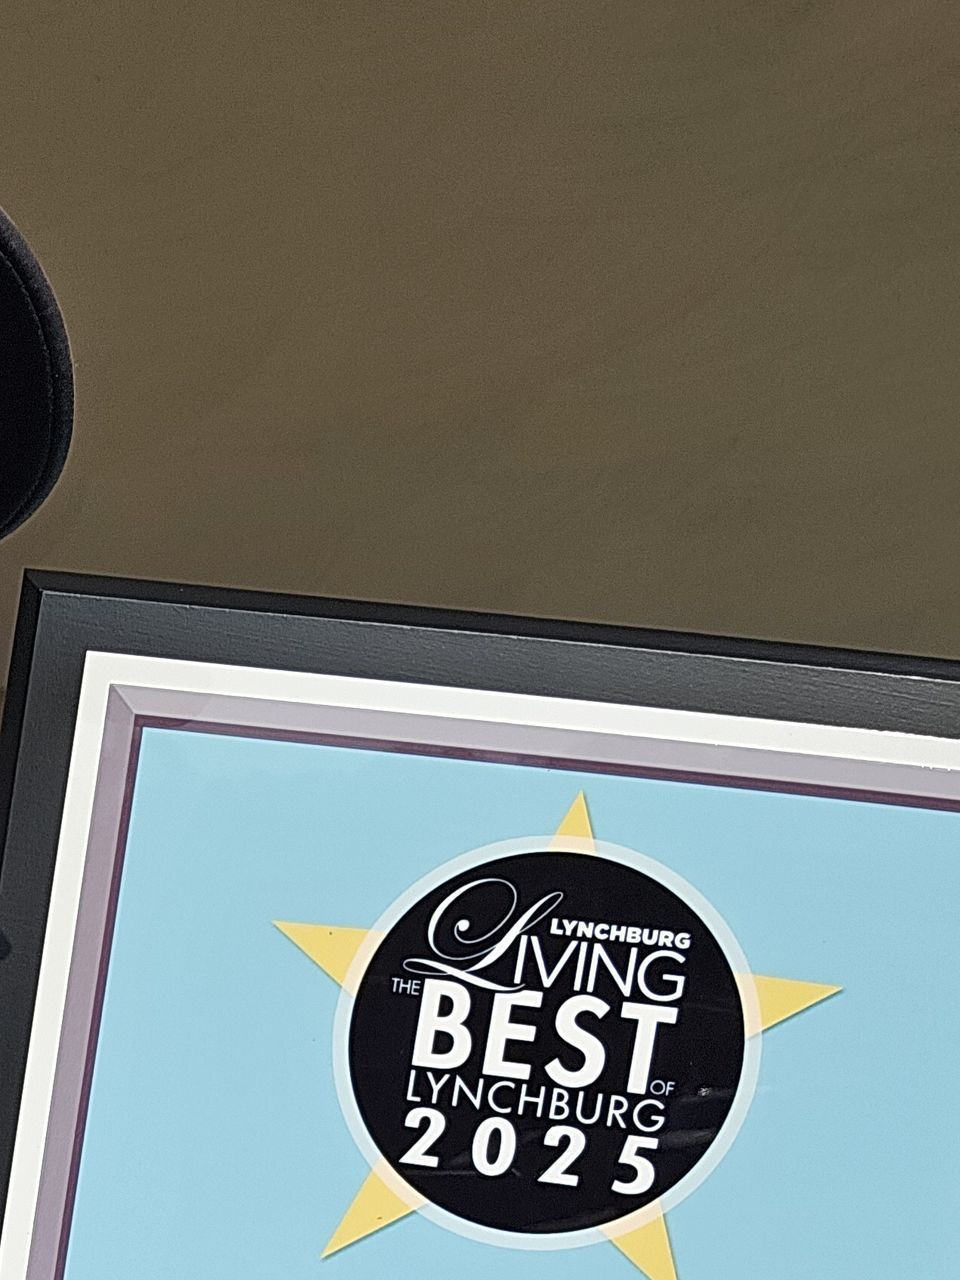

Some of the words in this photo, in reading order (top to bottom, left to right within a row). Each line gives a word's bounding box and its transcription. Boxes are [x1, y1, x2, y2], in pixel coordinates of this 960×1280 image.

[550, 918, 691, 950] LYNCHBURG
[392, 977, 421, 996] THE
[411, 978, 678, 1095] BEST
[407, 1070, 666, 1132] LYNCHBURG
[650, 1080, 676, 1097] OF
